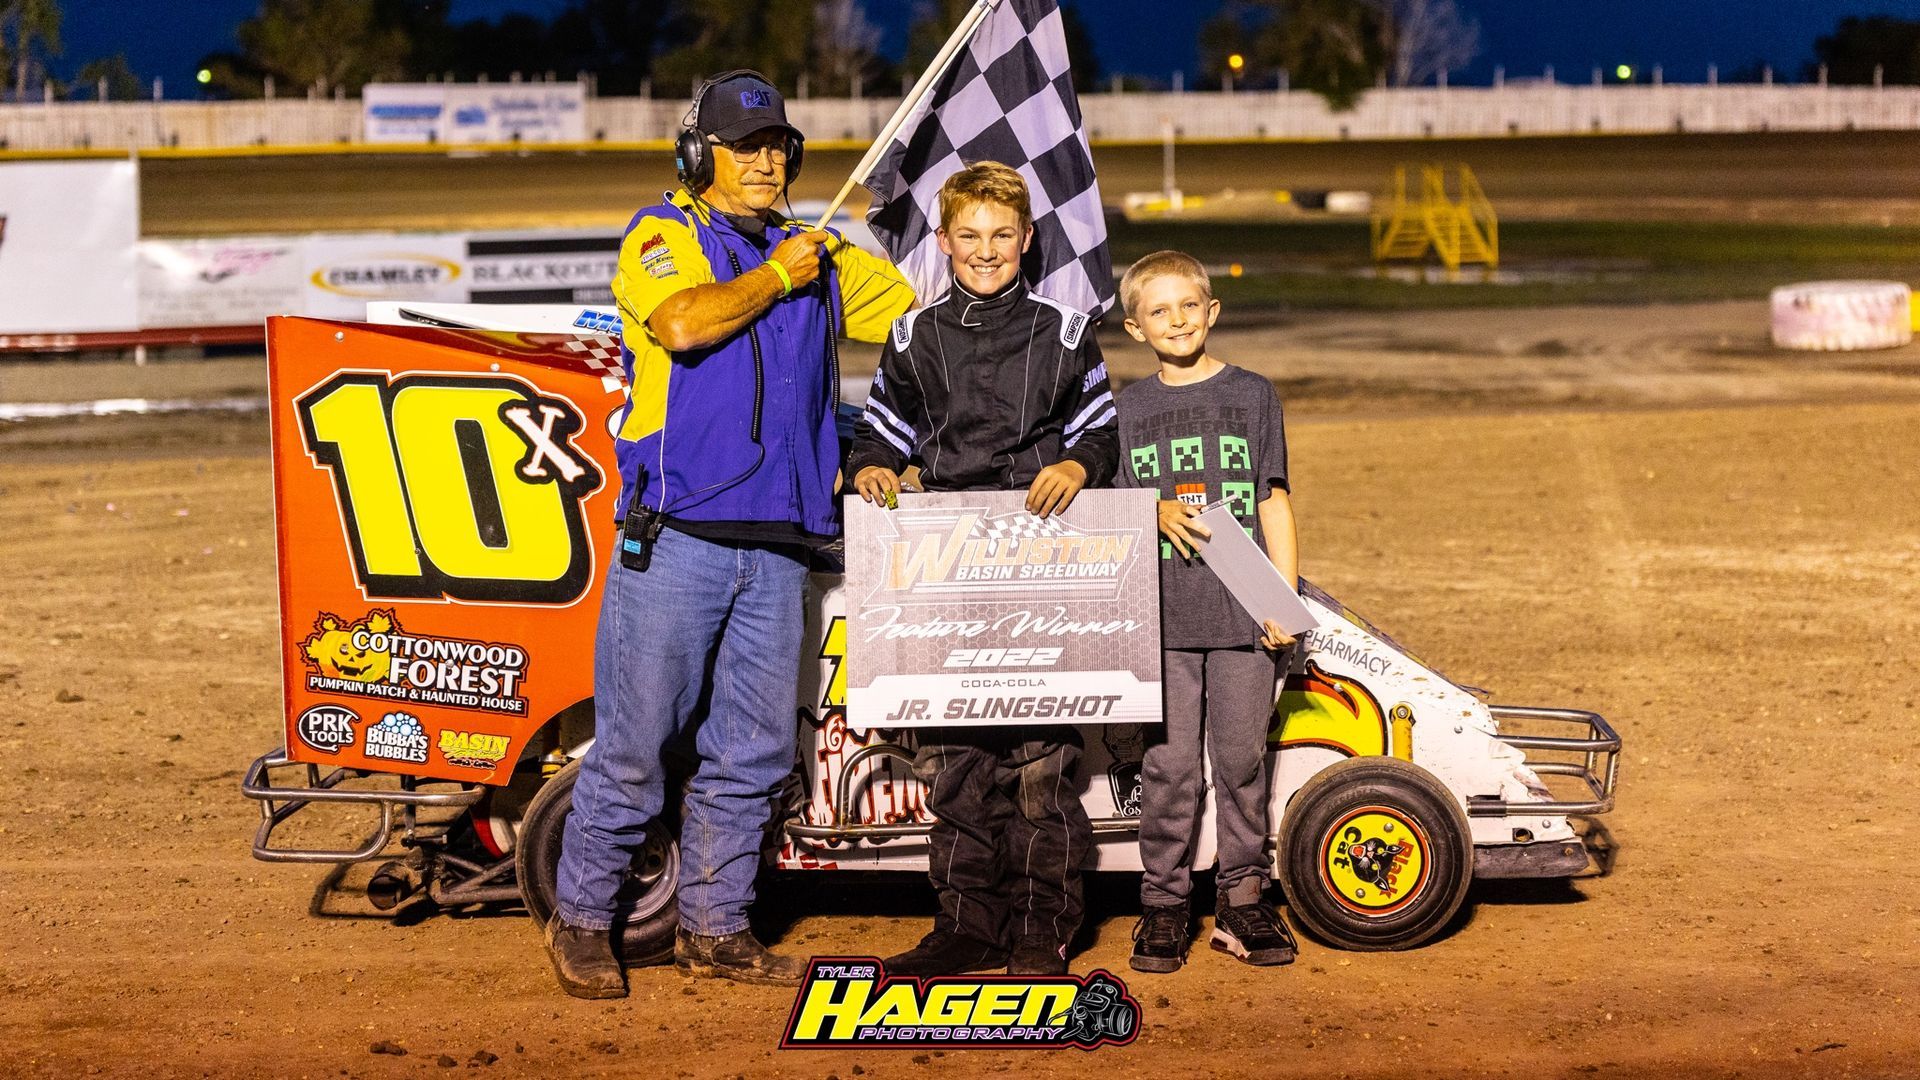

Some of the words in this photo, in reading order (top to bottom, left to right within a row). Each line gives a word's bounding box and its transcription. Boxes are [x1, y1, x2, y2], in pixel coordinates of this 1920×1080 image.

[740, 90, 771, 108] CAT
[329, 267, 439, 285] CHAMLEY
[1066, 315, 1081, 341] SIMPSON
[1181, 495, 1202, 504] TNT
[884, 514, 1133, 591] WILLISTON
[955, 564, 1013, 581] BASIN
[1019, 562, 1122, 580] SPEEDWAY
[859, 606, 991, 643] Feature
[992, 606, 1143, 639] Winner
[352, 631, 524, 668] COTTONWOOD
[942, 647, 1065, 668] 2022
[1301, 629, 1392, 676] PHARMACY
[389, 657, 521, 697] FOREST
[961, 677, 1047, 689] COCA-COLA
[310, 676, 364, 693] PUMPKIN
[367, 684, 406, 698] PATCH
[409, 689, 419, 700] &
[421, 690, 480, 706] HAUNTED
[481, 697, 523, 711] HOUSE
[886, 698, 931, 721] JR.
[943, 694, 1123, 720] SLINGSHOT
[308, 712, 353, 732] PRK
[308, 730, 354, 743] TOOLS
[367, 727, 428, 750] BUBBA'S
[438, 729, 511, 754] BASIN
[365, 743, 427, 762] BUBBLES
[1333, 826, 1362, 870] Cat
[1380, 837, 1415, 899] Black
